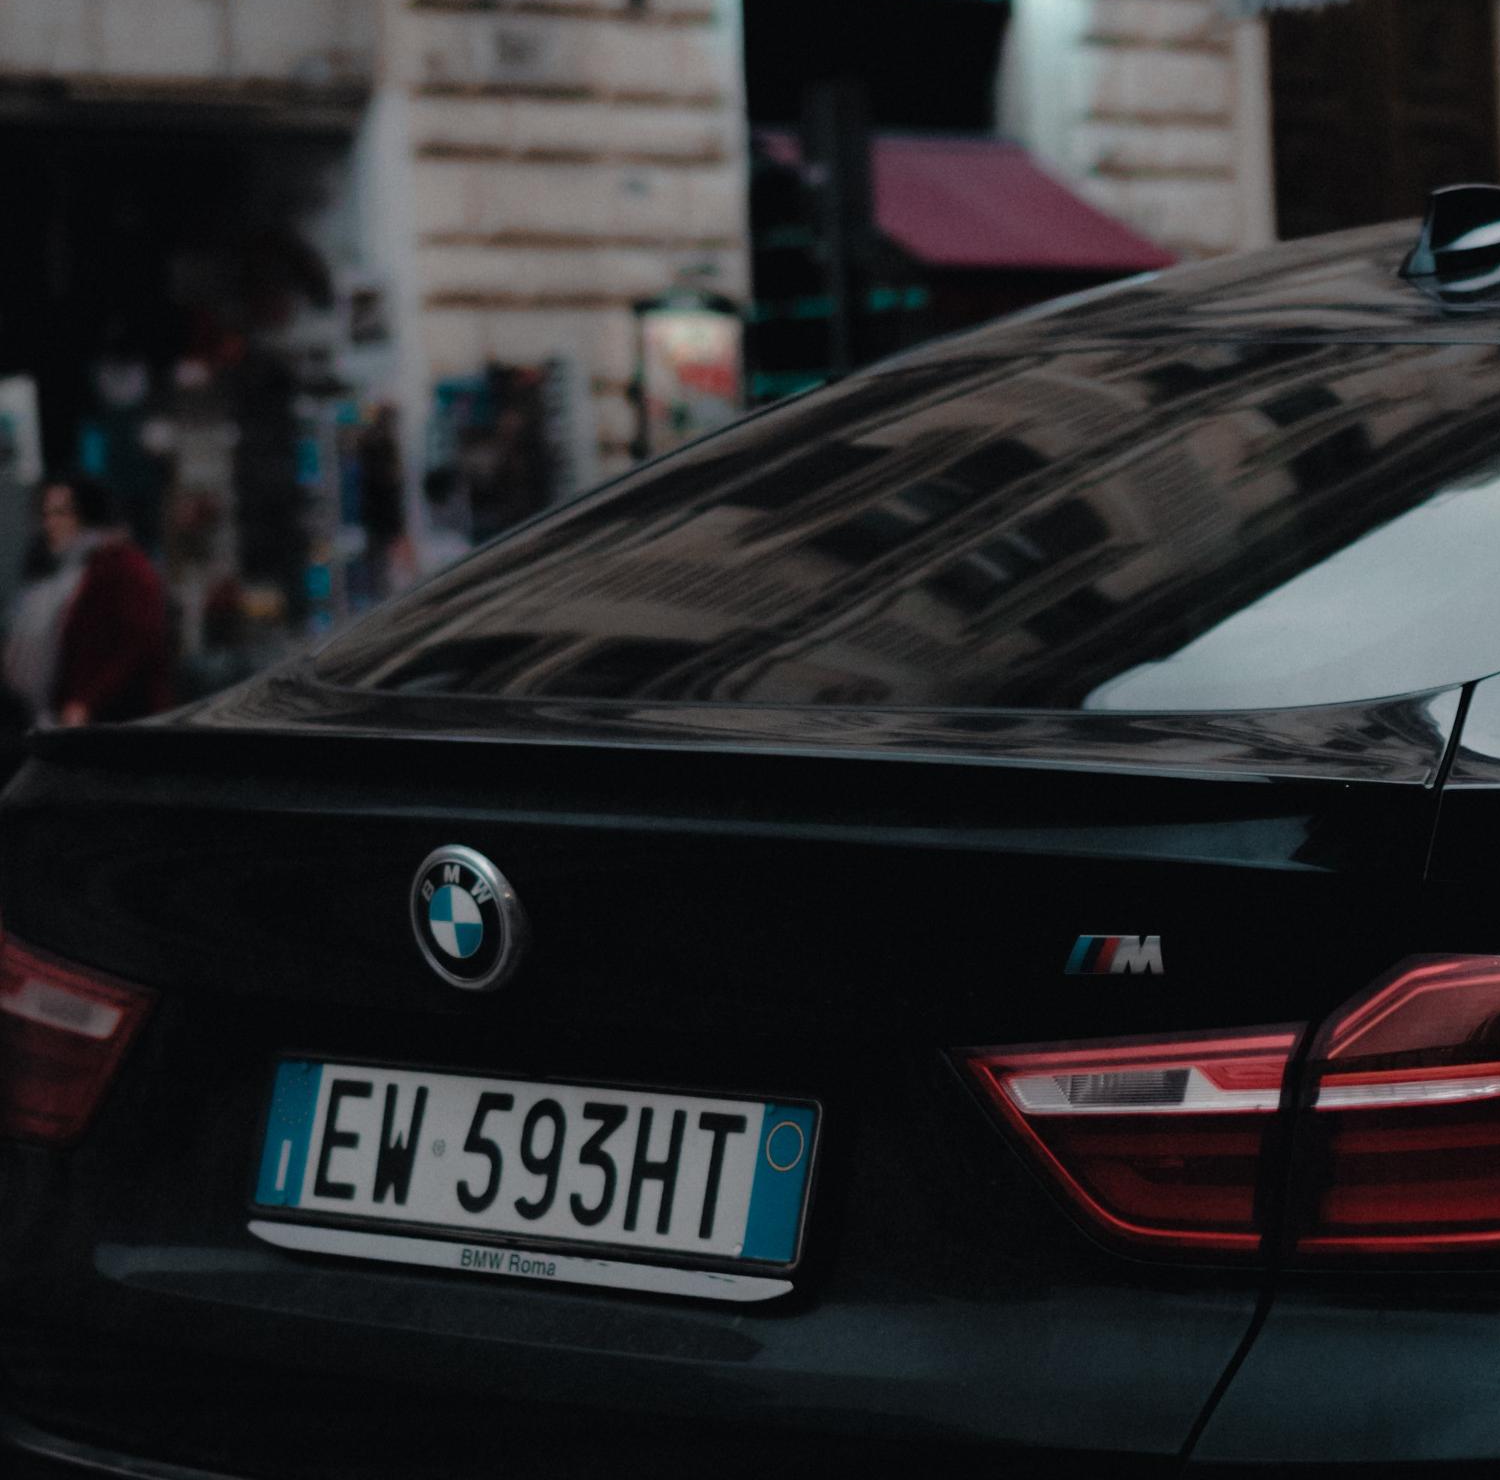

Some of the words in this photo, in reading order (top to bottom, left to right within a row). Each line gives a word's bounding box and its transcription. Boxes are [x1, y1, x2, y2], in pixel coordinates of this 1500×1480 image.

[421, 864, 493, 904] BMW
[313, 1079, 428, 1206] EW
[456, 1091, 748, 1239] 593HT
[460, 1248, 504, 1269] BMW
[509, 1253, 557, 1276] Roma
